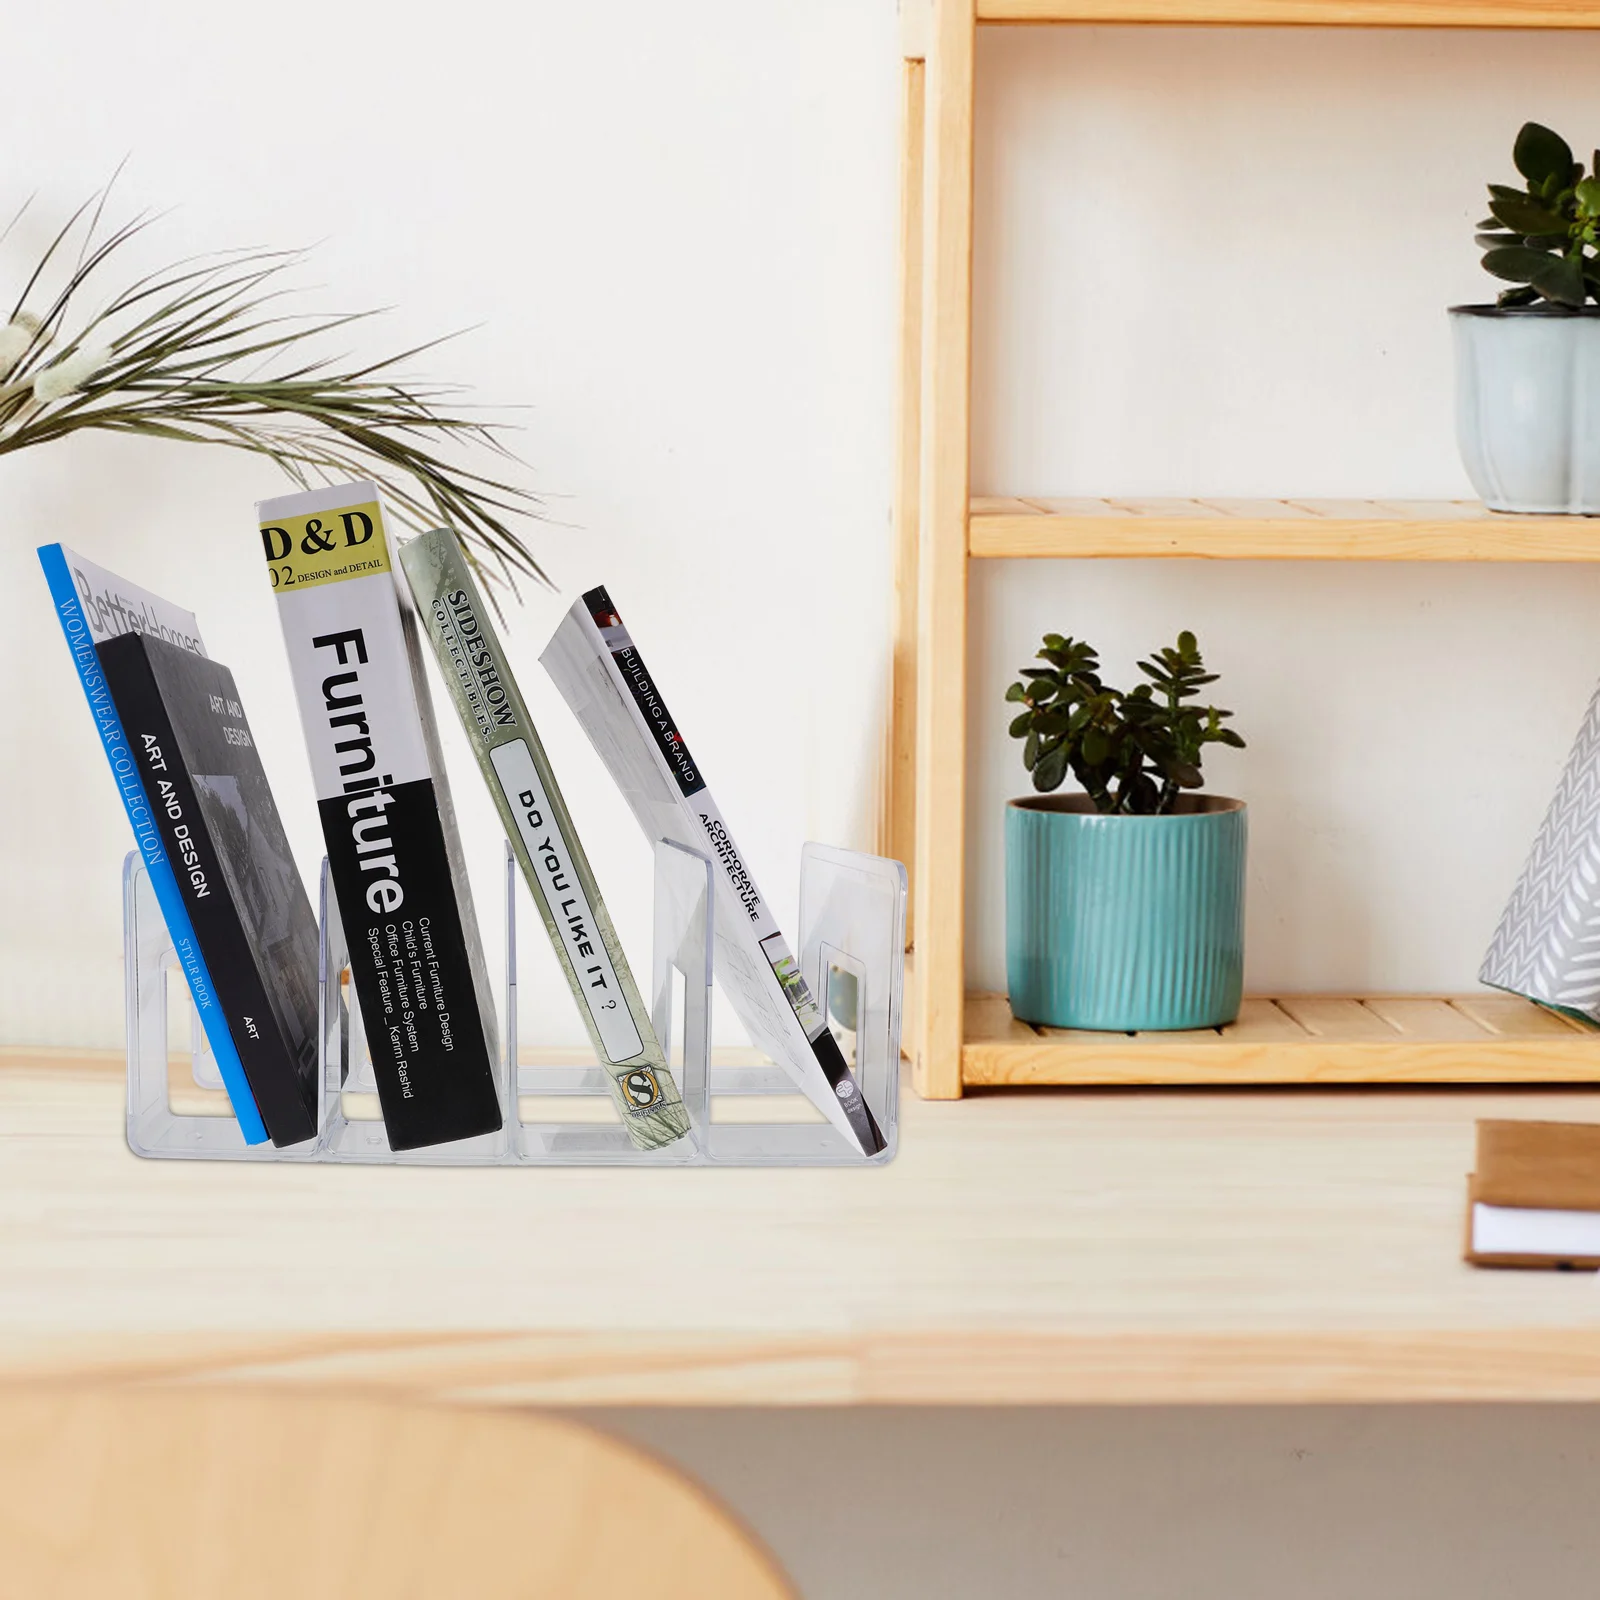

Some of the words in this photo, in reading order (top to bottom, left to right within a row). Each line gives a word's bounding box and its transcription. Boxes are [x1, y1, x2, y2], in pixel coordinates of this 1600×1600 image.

[260, 527, 292, 562] D
[301, 519, 337, 555] &
[338, 511, 374, 548] D
[297, 569, 332, 583] DESIGN
[333, 565, 348, 576] and
[349, 559, 383, 573] DETAIL
[209, 693, 226, 715] ART
[226, 698, 243, 718] AND
[448, 589, 518, 728] SIDESHOW
[60, 598, 121, 743] WOMENSWEAR
[111, 746, 164, 865] COLLECTION
[222, 726, 253, 747] DESIGN
[621, 647, 663, 719] BUILDING
[657, 720, 667, 731] A
[663, 730, 695, 783] BRAND
[141, 733, 168, 772] ART
[157, 780, 182, 820] AND
[174, 824, 211, 899] DESIGN
[312, 628, 405, 914] Furniture
[518, 789, 543, 828] DO
[538, 836, 570, 891] YOU
[561, 898, 594, 958] LIKE
[587, 965, 608, 989] IT
[601, 999, 617, 1010] ?
[699, 813, 760, 922] ARCHITECTURE
[713, 820, 760, 906] CORPORATE
[178, 938, 199, 976] STYLR
[192, 976, 212, 1010] BOOK
[367, 927, 385, 969] Special
[377, 971, 394, 1014] Feature
[389, 1025, 404, 1059] Karim
[397, 1060, 414, 1099] Rashid
[385, 924, 399, 957] Office
[392, 959, 410, 1009] Furniture
[403, 1010, 420, 1053] System
[402, 920, 417, 958] Child's
[410, 960, 428, 1010] Furniture
[418, 917, 435, 960] Current
[428, 961, 445, 1011] Furniture
[438, 1012, 454, 1052] Design
[243, 1016, 260, 1040] ART
[844, 1097, 859, 1108] BOOK
